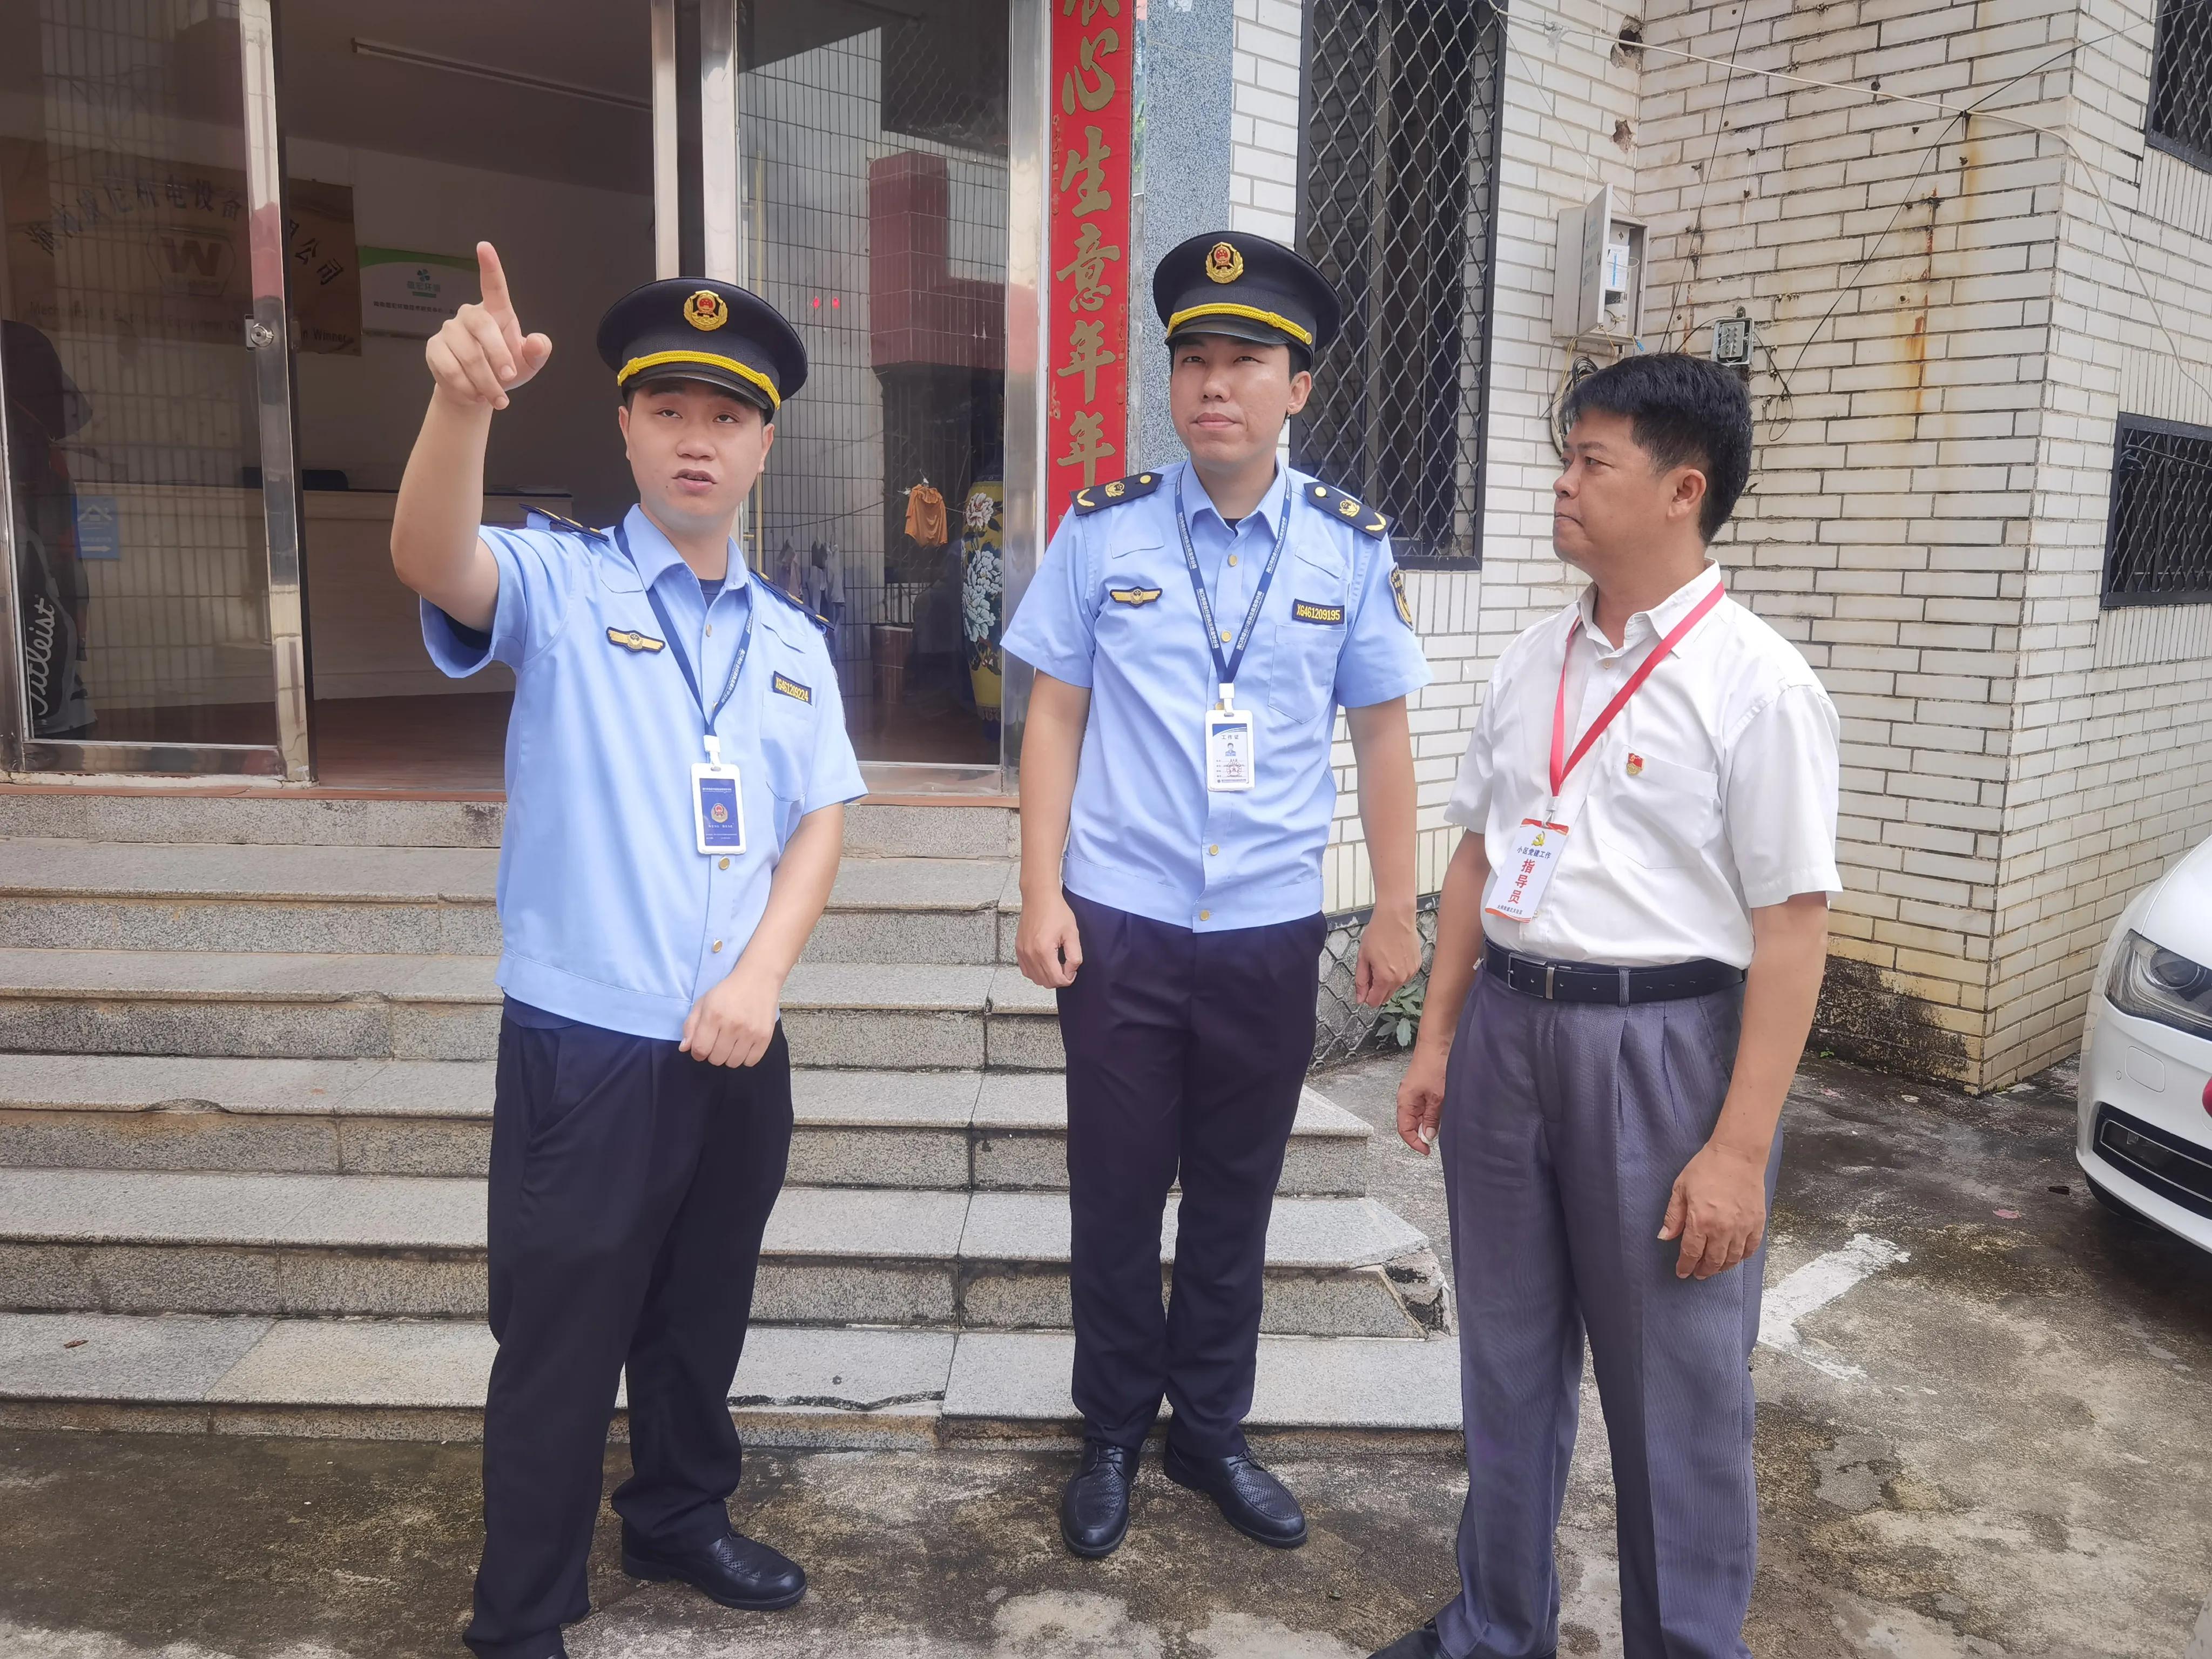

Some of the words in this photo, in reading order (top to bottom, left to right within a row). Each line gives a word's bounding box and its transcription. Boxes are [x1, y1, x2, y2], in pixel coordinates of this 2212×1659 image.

[1297, 604, 1340, 621] XG461209195
[1516, 846, 1552, 859] 小区党建工作
[1508, 859, 1535, 905] 指导员
